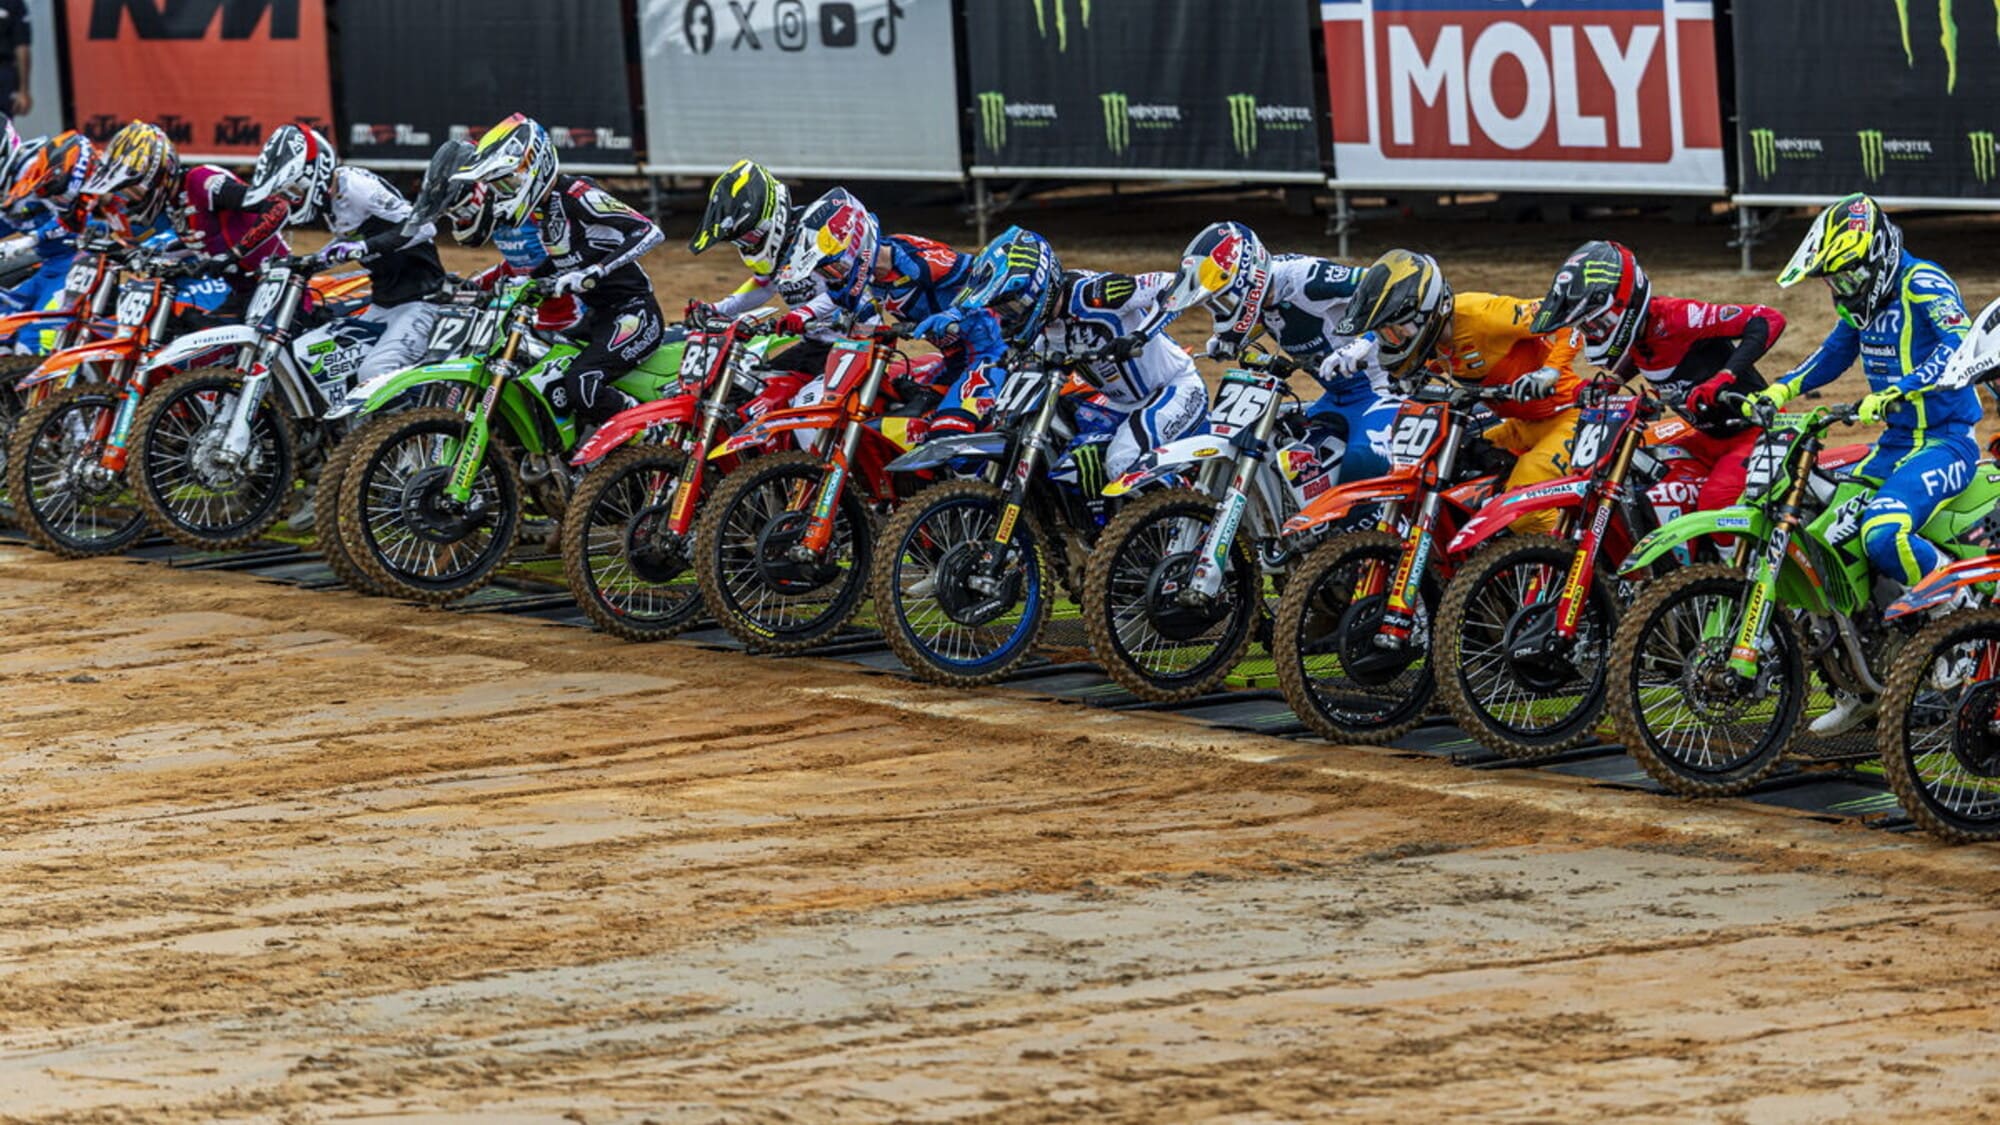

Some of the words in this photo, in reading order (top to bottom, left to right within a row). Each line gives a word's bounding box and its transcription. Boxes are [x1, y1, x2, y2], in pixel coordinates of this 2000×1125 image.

[1388, 21, 1661, 150] MOLY
[215, 116, 261, 145] KTM
[1248, 269, 1269, 303] Bull
[429, 317, 468, 350] 12
[323, 345, 364, 365] SIXTY
[328, 359, 367, 378] SEVE
[828, 353, 856, 389] 1
[994, 372, 1042, 412] 47
[1212, 383, 1272, 427] 26
[1391, 418, 1439, 456] 20
[455, 425, 479, 487] DUNLOP
[1646, 482, 1699, 505] HON
[1743, 584, 1766, 642] DUNLOP
